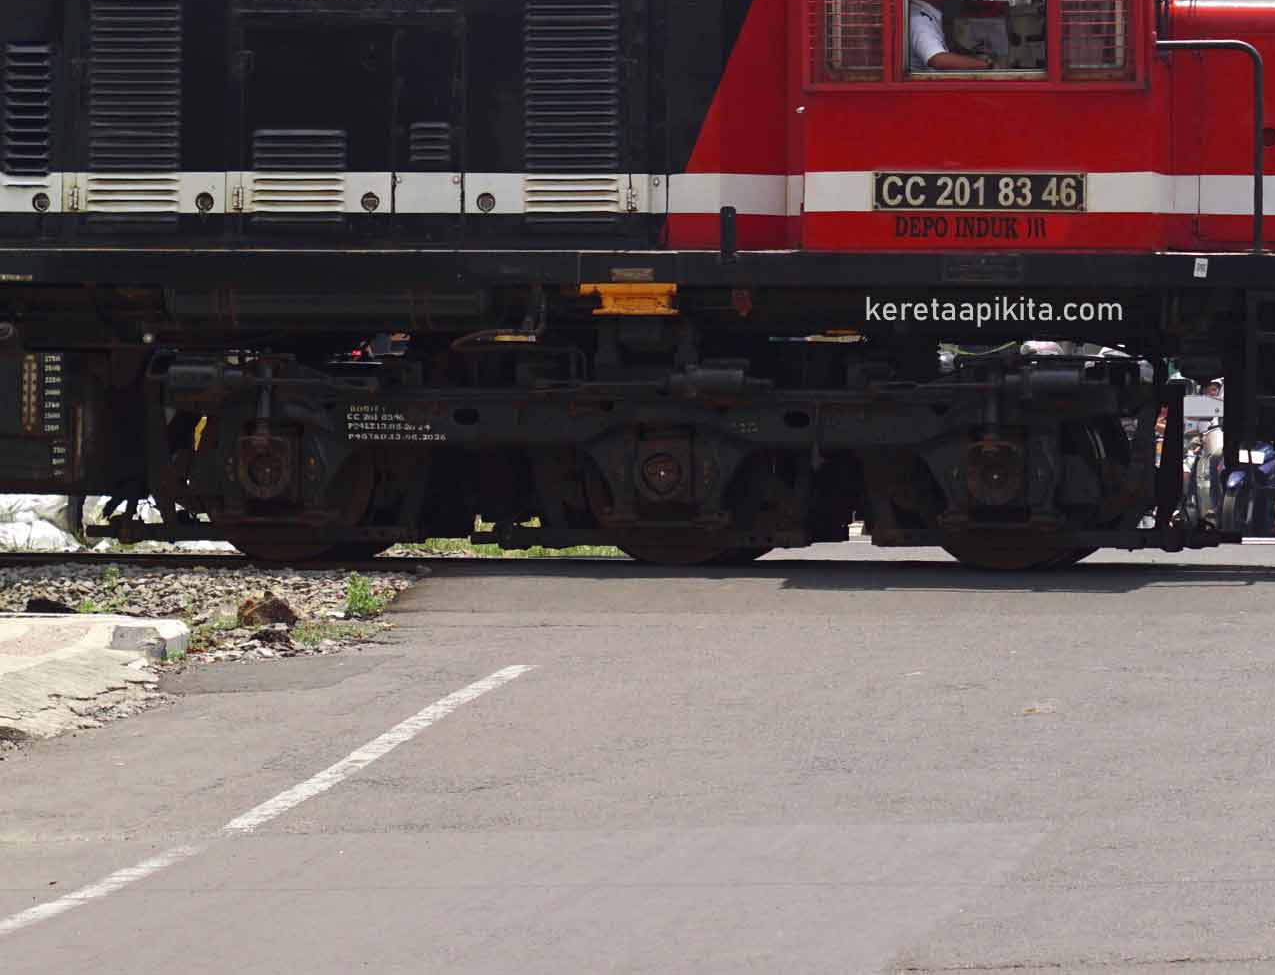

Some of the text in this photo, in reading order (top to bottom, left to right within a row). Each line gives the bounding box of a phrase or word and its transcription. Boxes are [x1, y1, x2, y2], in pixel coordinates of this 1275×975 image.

[882, 176, 1076, 206] CC 201 83 46
[895, 216, 949, 238] DEPO
[955, 216, 1019, 239] INDUK
